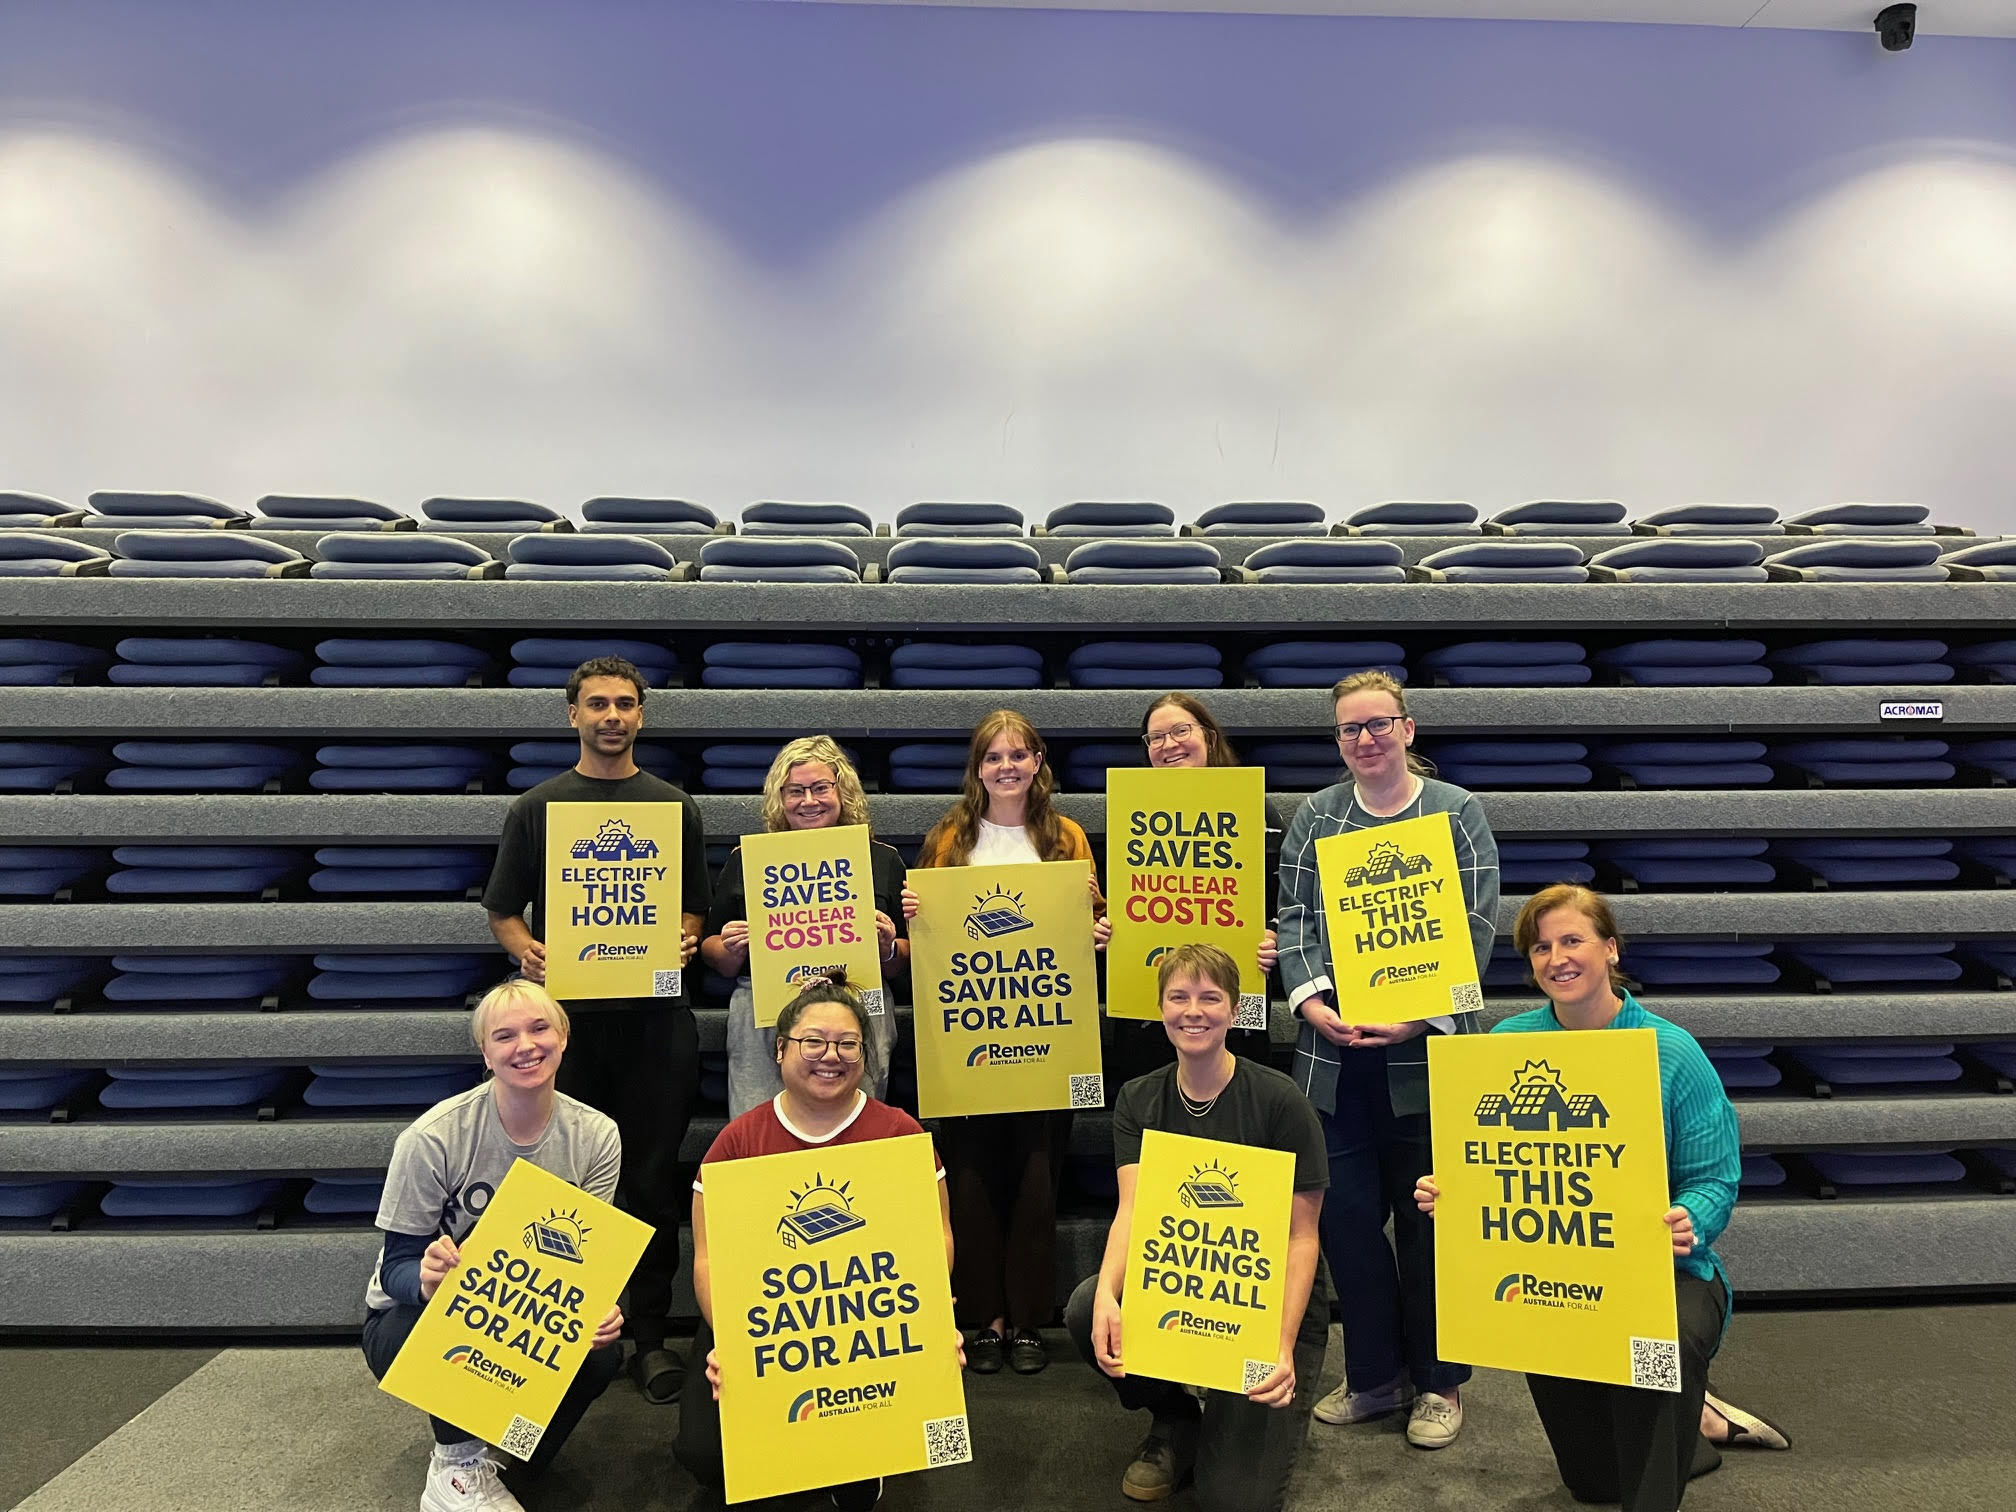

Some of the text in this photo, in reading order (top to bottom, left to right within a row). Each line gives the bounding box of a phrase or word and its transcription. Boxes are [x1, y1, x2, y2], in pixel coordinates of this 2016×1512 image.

[1884, 706, 1939, 715] ACROMAT
[1130, 810, 1239, 838] SOLAR
[1126, 840, 1243, 870] SAVES.
[562, 867, 668, 882] ELECTRIFY
[764, 858, 853, 884] SOLAR
[1132, 874, 1238, 896] NUCLEAR
[582, 883, 646, 904] THIS
[763, 880, 858, 908] SAVES.
[1339, 878, 1444, 912] ELECTRIFY
[572, 905, 657, 926] HOME
[768, 906, 856, 928] NUCLEAR
[1126, 895, 1244, 928] COSTS.
[1362, 900, 1428, 929] THIS
[598, 944, 648, 956] Renew
[766, 923, 862, 951] COSTS.
[1355, 918, 1444, 954] HOME
[951, 948, 1057, 976] SOLAR
[1387, 961, 1440, 978] Renew
[938, 973, 1072, 1004] SAVINGS
[1389, 976, 1416, 985] AUSTRALIA
[943, 1002, 1072, 1032] FOR ALL
[989, 1044, 1050, 1058] Renew
[1465, 1141, 1626, 1168] ELECTRIFY
[1494, 1169, 1593, 1207] THIS
[1159, 1216, 1260, 1253] SOLAR
[1482, 1206, 1614, 1248] HOME
[1143, 1239, 1270, 1281] SAVINGS
[487, 1249, 584, 1313] SOLAR
[762, 1251, 899, 1299] SOLAR
[1142, 1267, 1266, 1310] FOR ALL
[1522, 1274, 1603, 1302] Renew
[460, 1268, 584, 1344] SAVINGS
[748, 1284, 920, 1338] SAVINGS
[1523, 1298, 1598, 1312] AUSTRALIA FOR ALL
[445, 1294, 560, 1372] FOR ALL
[1180, 1328, 1211, 1338] AUSTRALIA
[1181, 1311, 1240, 1336] Renew
[755, 1323, 923, 1377] FOR ALL
[464, 1365, 494, 1384] AUSTRALIA
[468, 1349, 528, 1388] Renew
[816, 1380, 896, 1409] Renew
[818, 1400, 893, 1418] AUSTRALIA FOR ALL
